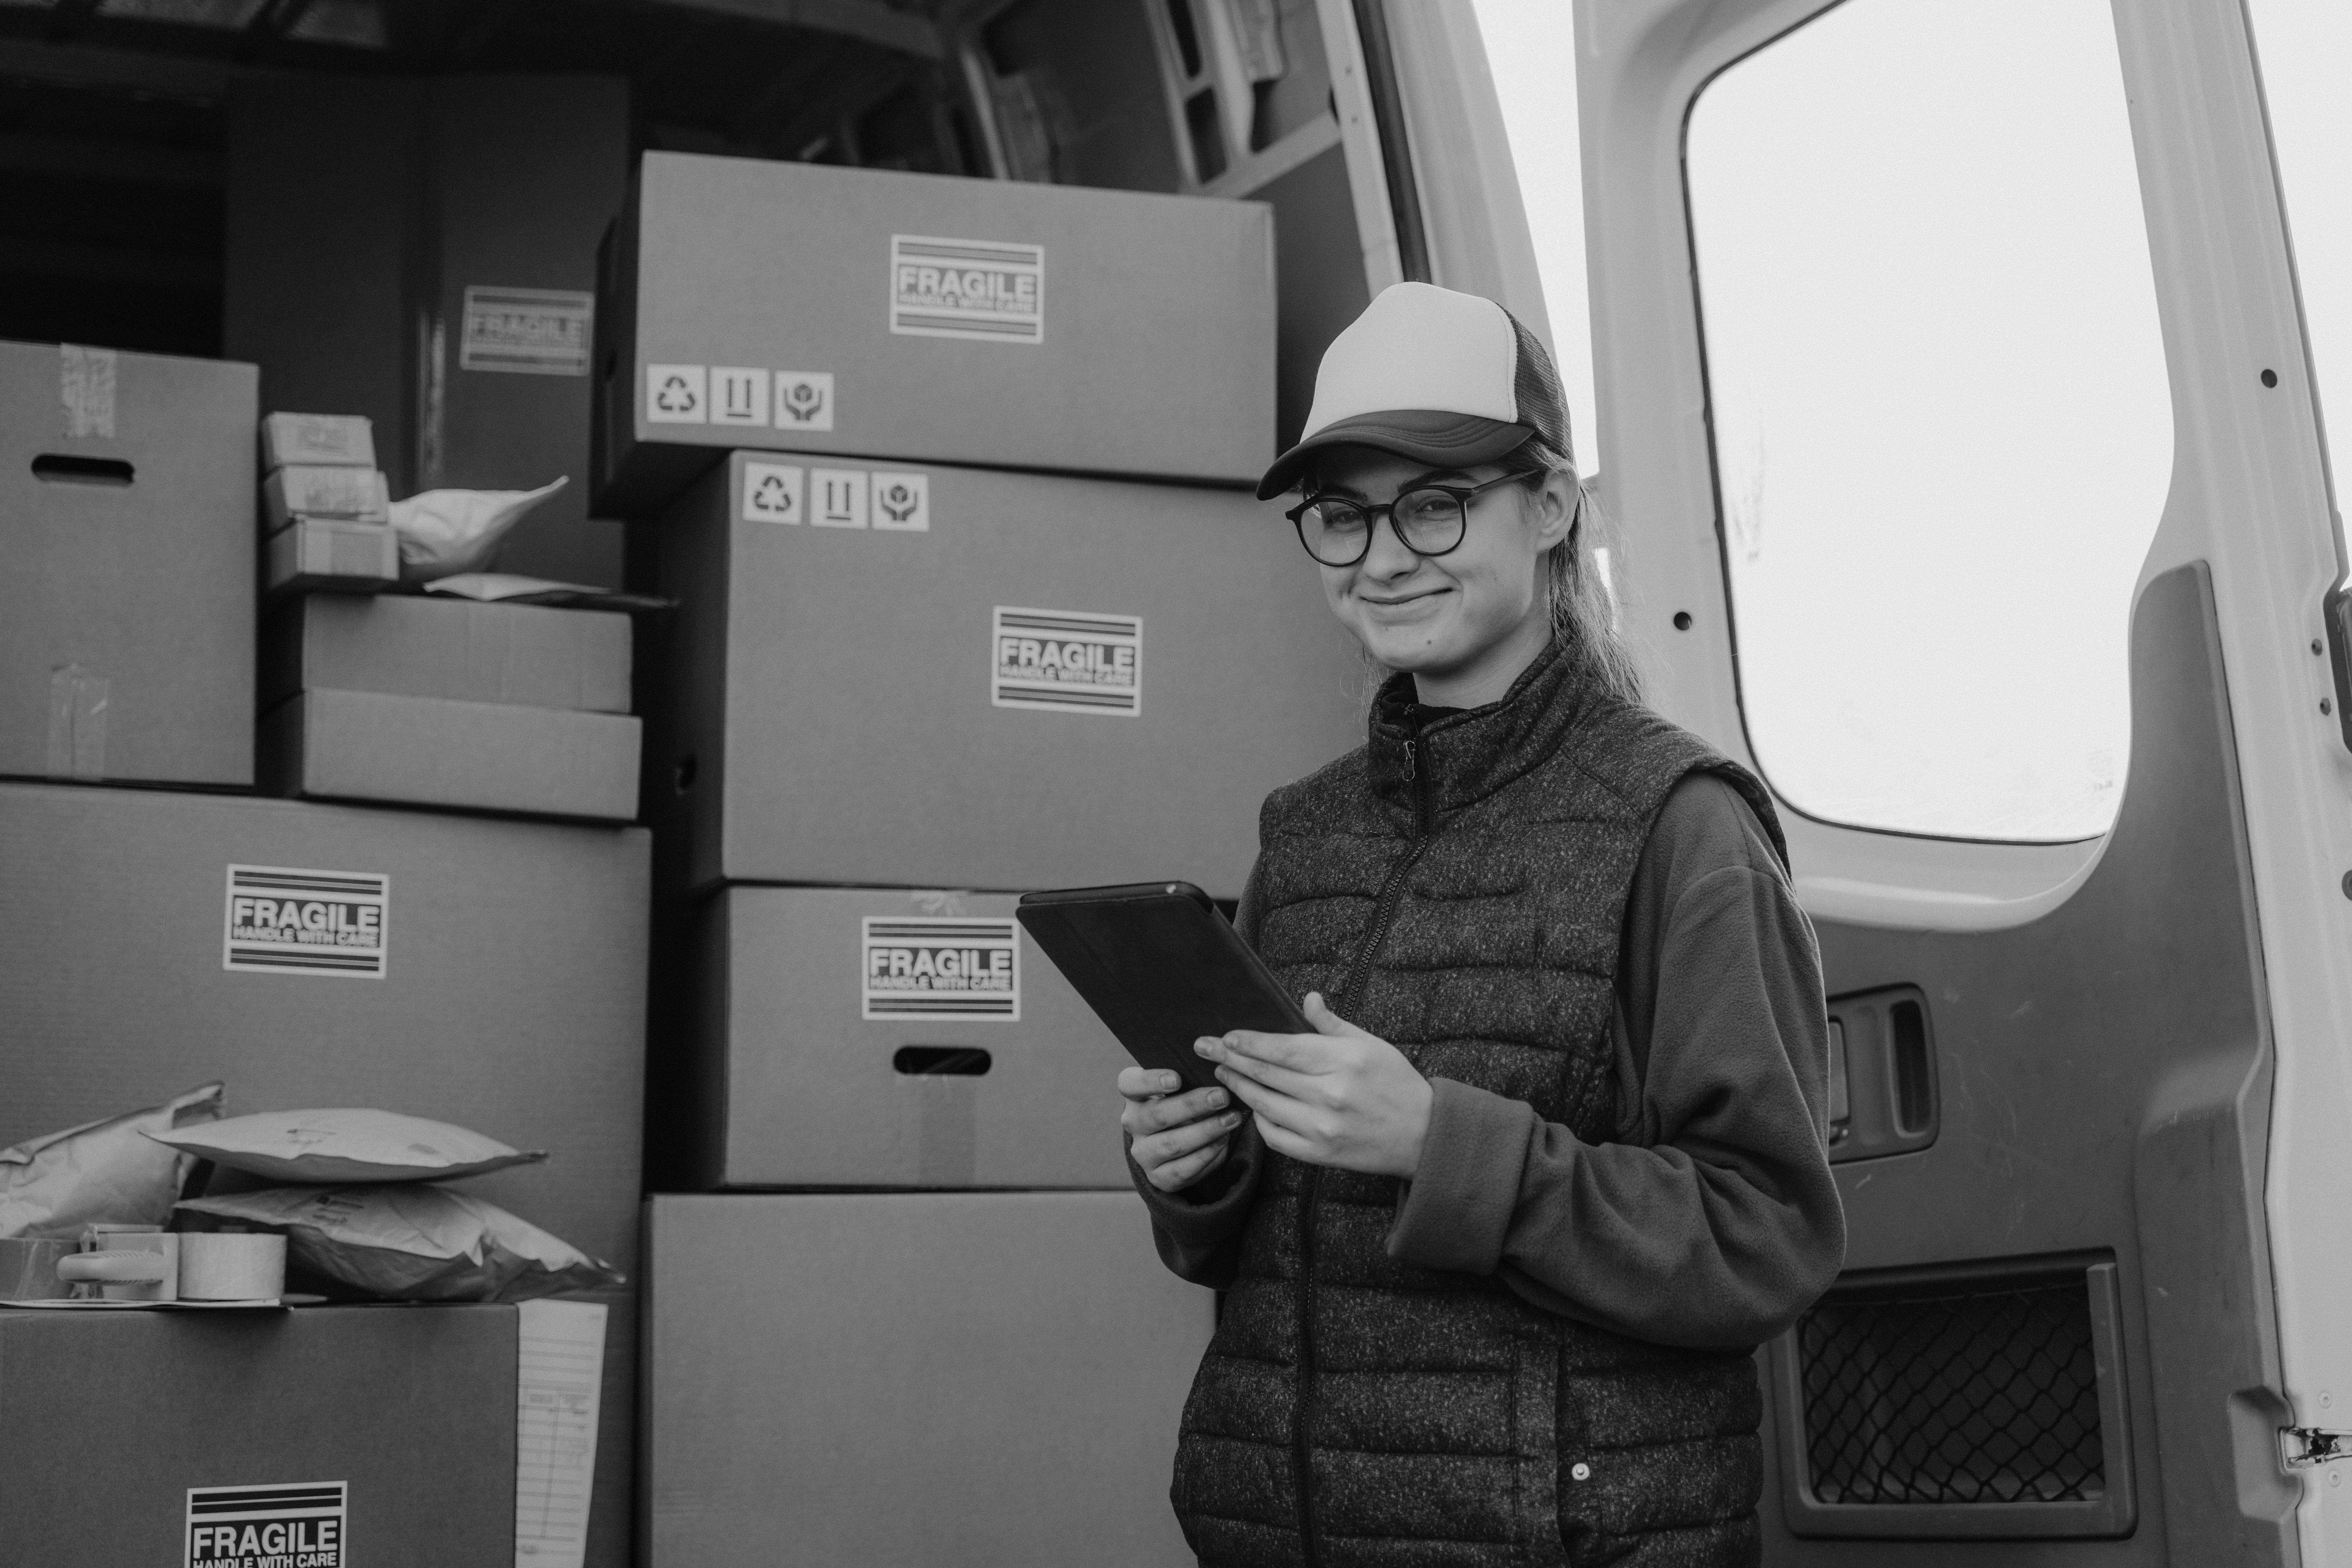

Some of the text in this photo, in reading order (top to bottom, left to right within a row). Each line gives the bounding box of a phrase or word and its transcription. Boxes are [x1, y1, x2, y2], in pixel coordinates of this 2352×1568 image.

[899, 266, 1036, 302] FRAGILE
[1001, 637, 1134, 672] FRAGILE
[234, 898, 379, 933] FRAGILE
[869, 949, 1011, 977] FRAGILE
[193, 1520, 338, 1559] FRAGILE
[193, 1552, 336, 1568] HANDLE WITH CARE
